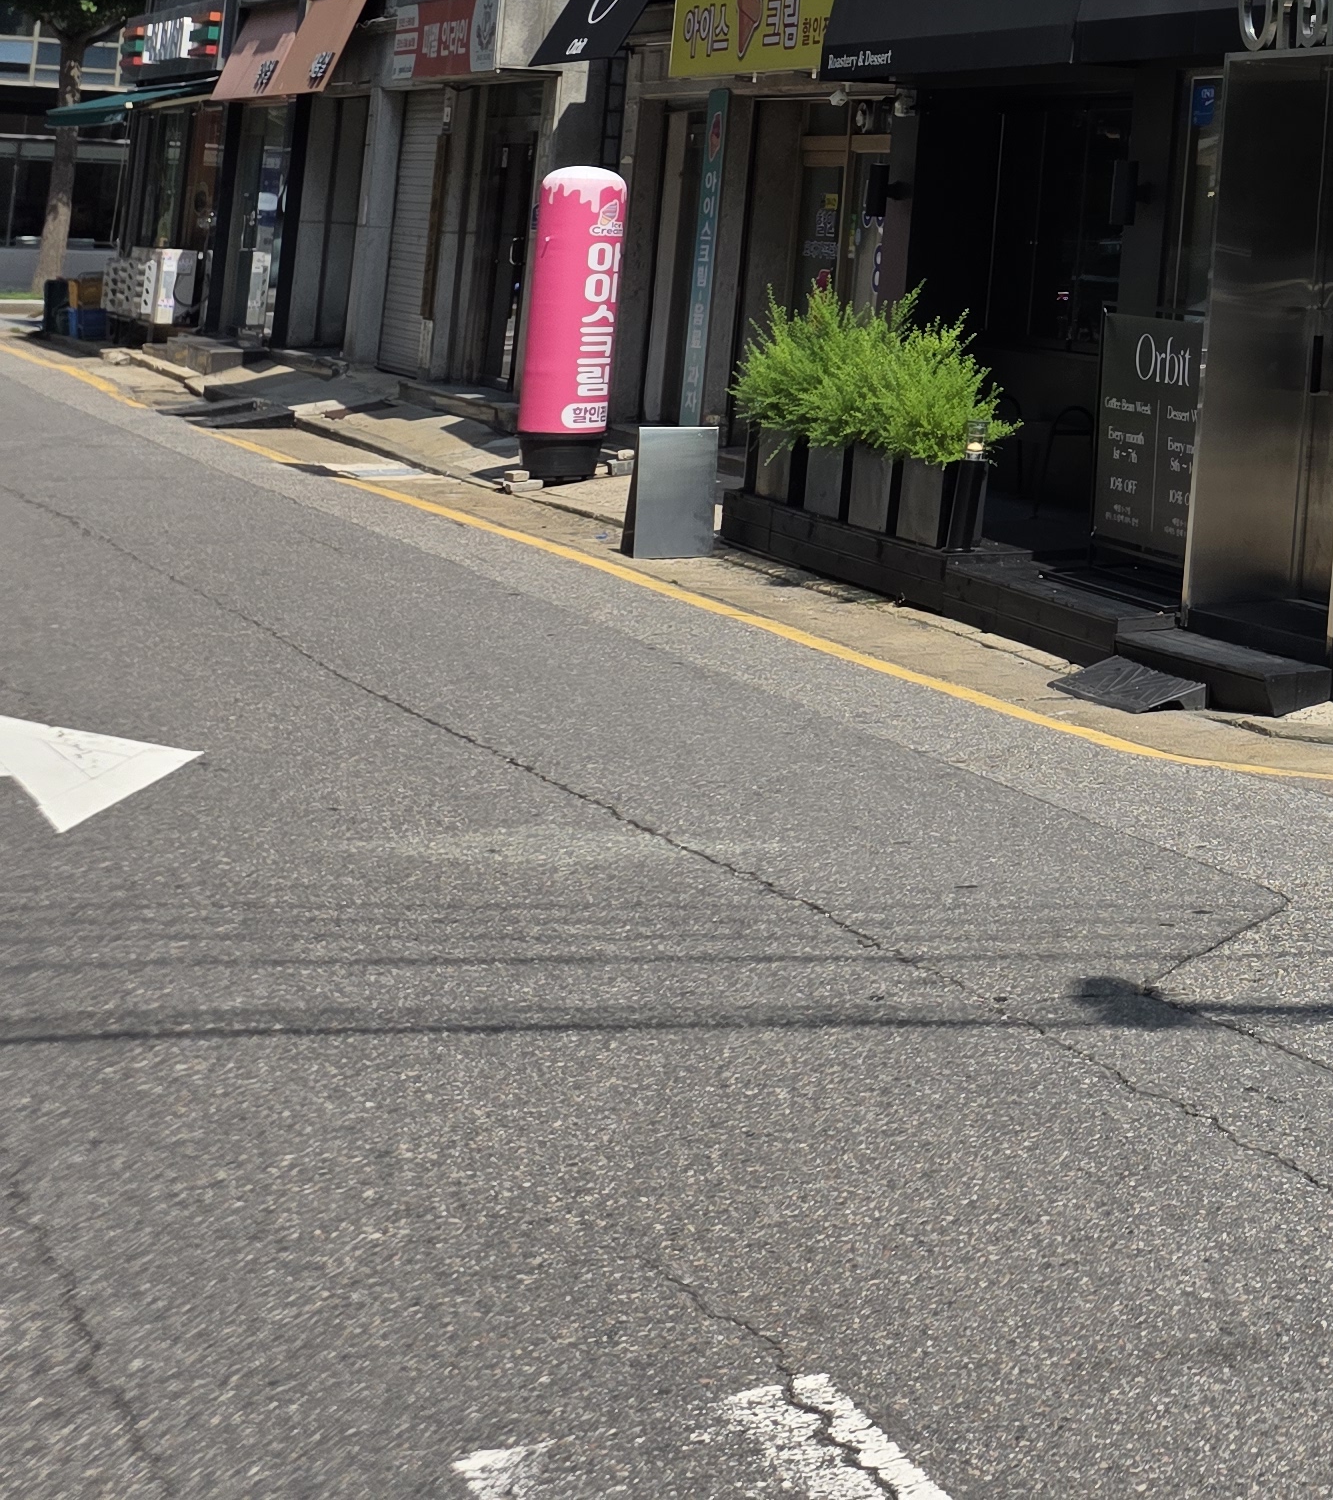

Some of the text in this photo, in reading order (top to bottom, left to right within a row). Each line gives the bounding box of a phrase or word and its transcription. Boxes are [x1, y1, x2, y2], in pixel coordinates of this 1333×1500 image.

[684, 3, 730, 59] 아이스
[828, 49, 892, 71] Roastery & Dessert
[576, 242, 622, 397] 아이스크림
[1135, 333, 1192, 387] Orbit
[1104, 396, 1121, 410] Coffee
[1166, 405, 1190, 423] Dessert
[1107, 425, 1125, 445] Every
[1167, 436, 1186, 457] Every
[1123, 479, 1138, 495] OFF
